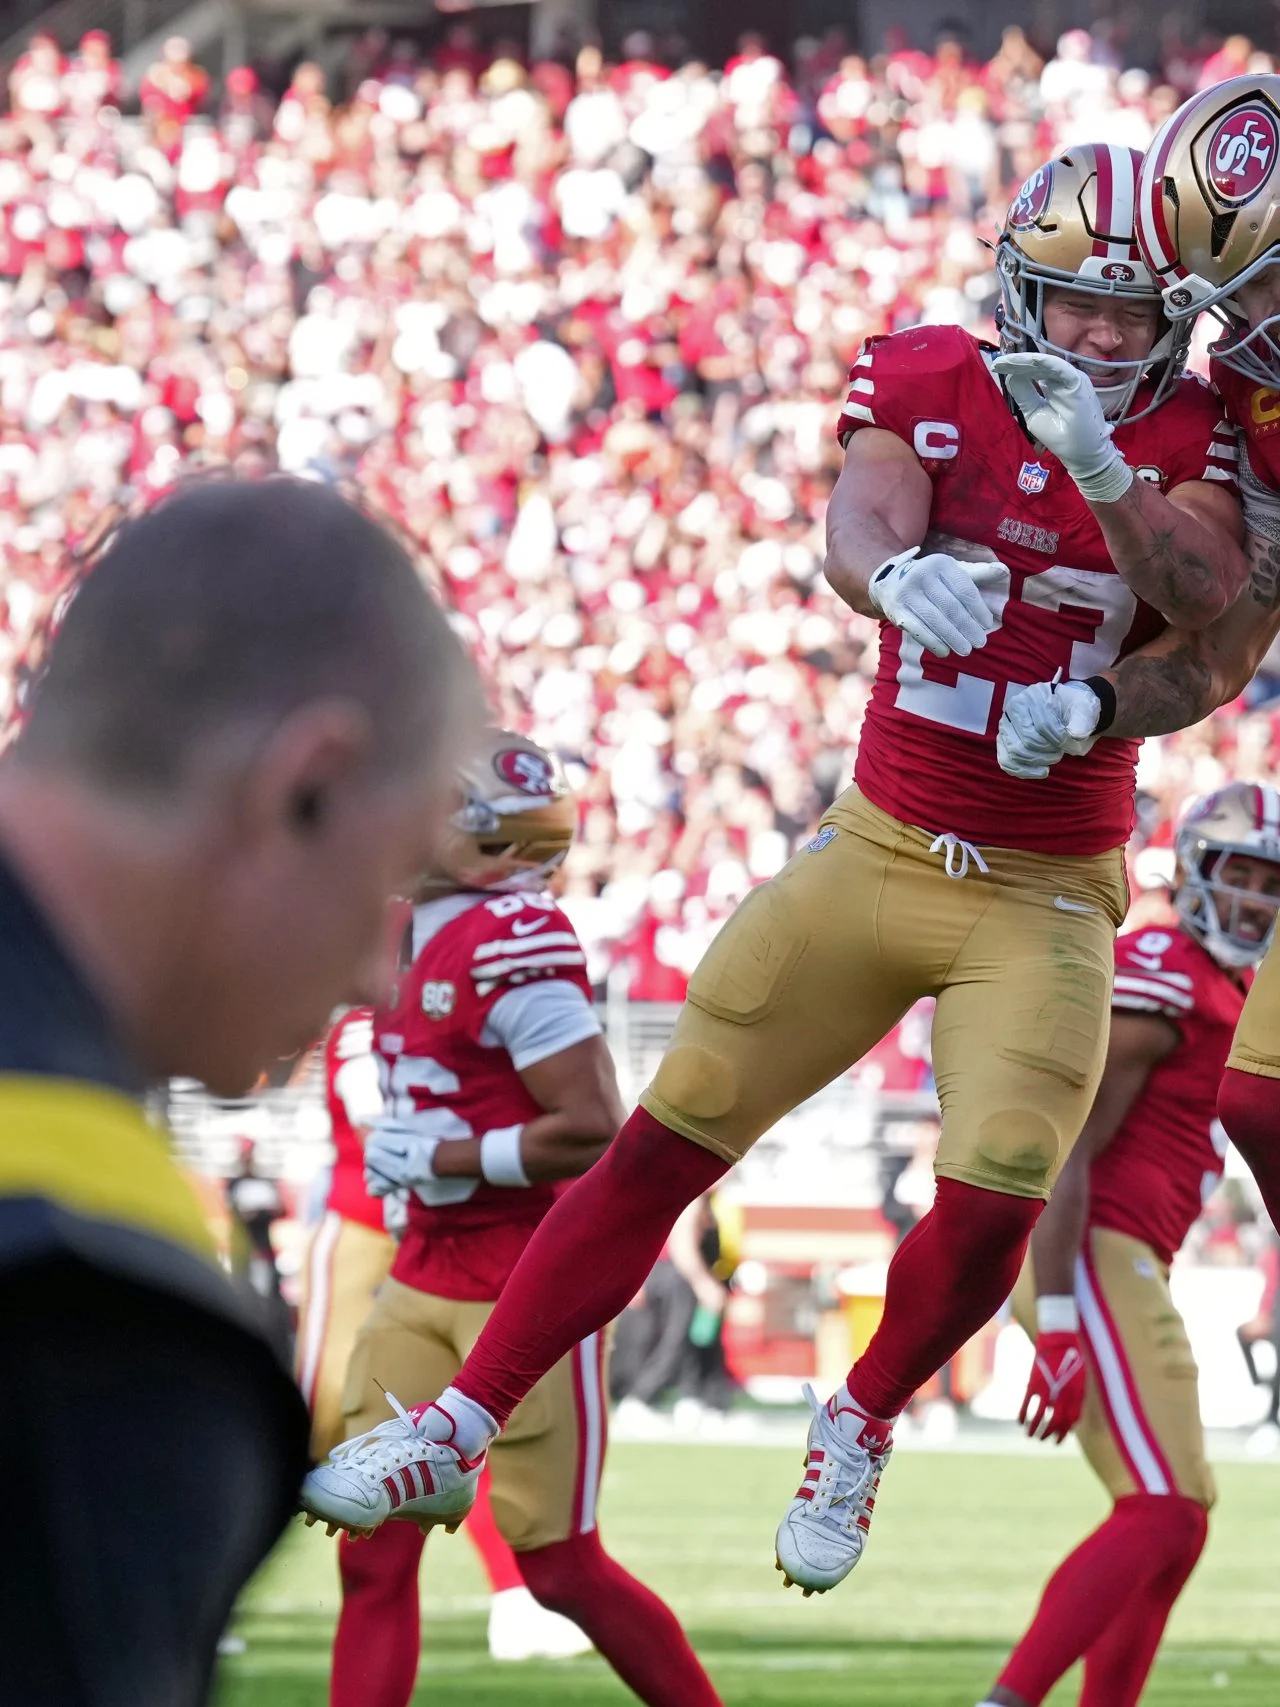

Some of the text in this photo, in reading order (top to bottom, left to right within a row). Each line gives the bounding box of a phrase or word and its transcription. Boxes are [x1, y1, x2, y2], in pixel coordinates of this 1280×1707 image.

[1215, 119, 1271, 177] SF
[914, 421, 959, 460] C
[1022, 475, 1040, 489] NFL
[997, 517, 1059, 555] 49ERS
